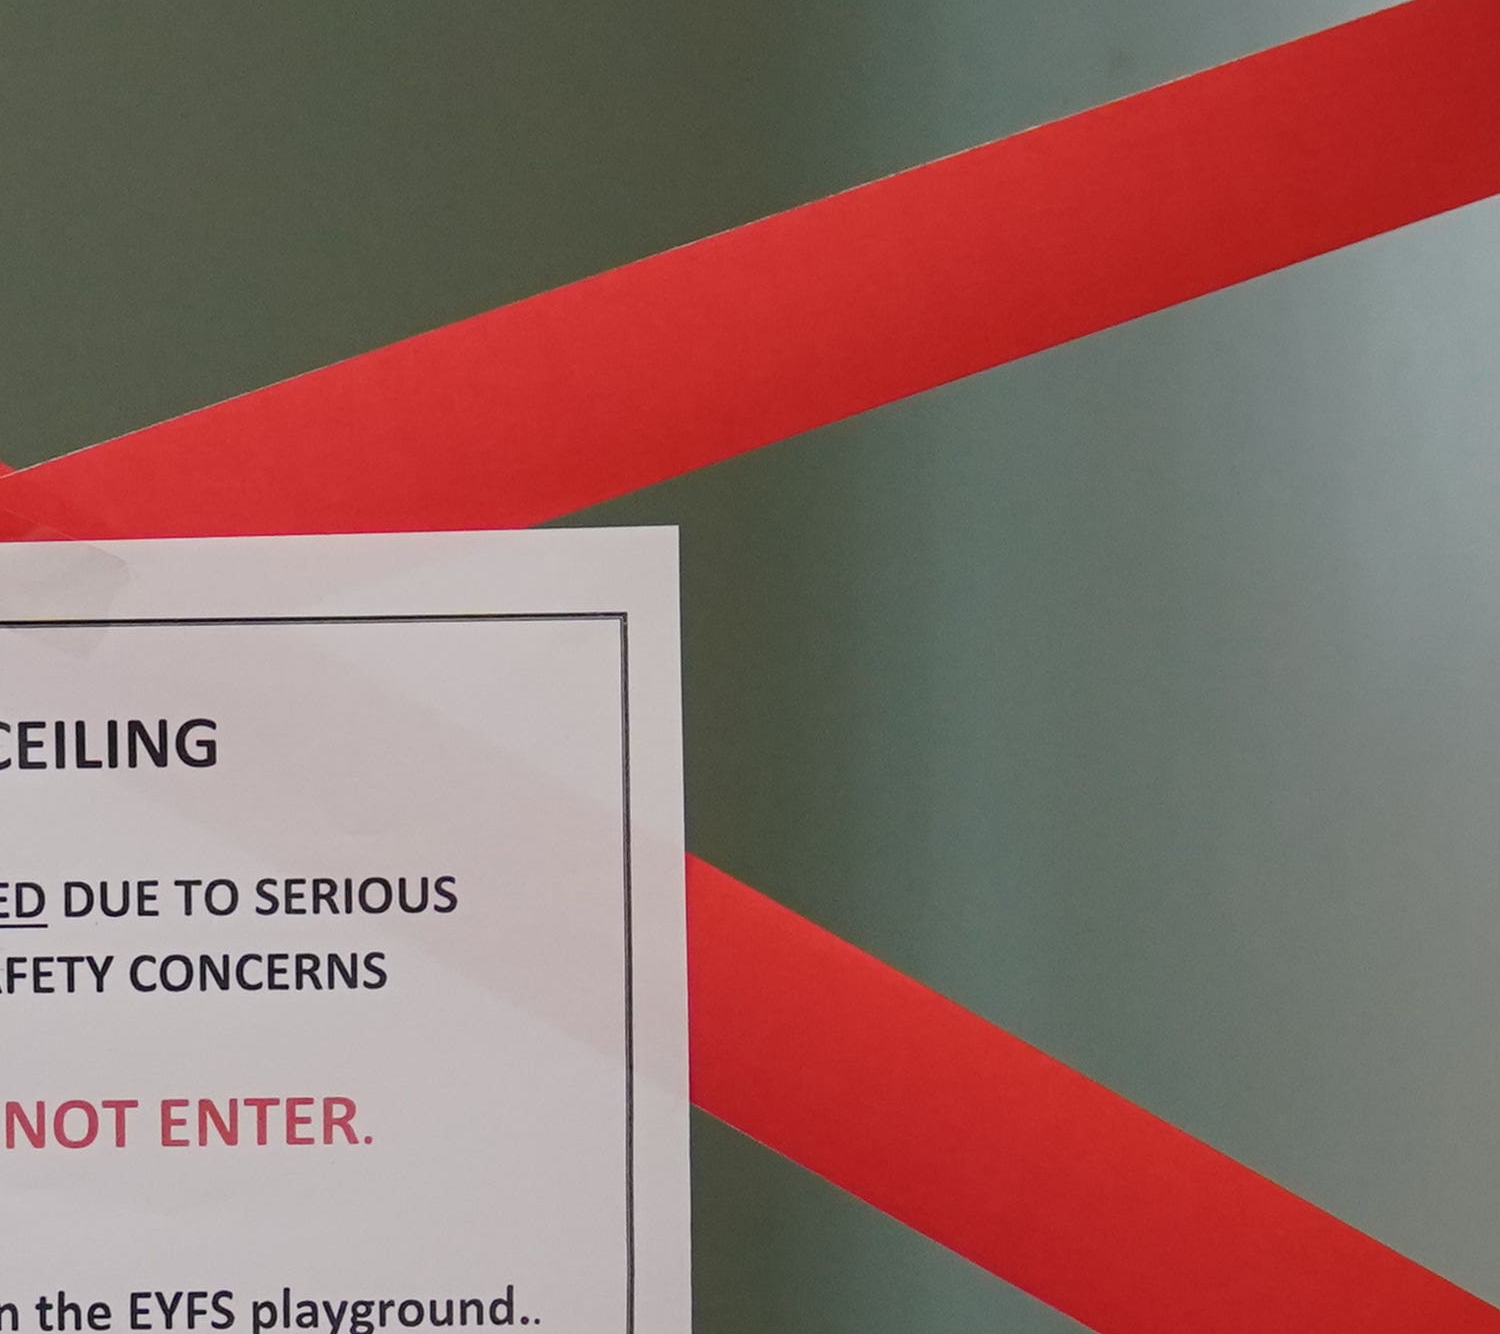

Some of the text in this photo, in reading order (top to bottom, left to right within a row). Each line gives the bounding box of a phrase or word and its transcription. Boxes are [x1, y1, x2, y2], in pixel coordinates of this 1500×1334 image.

[62, 878, 161, 919] DUE
[172, 878, 240, 918] TO
[254, 874, 459, 917] SERIOUS
[128, 950, 389, 994] CONCERNS
[4, 1098, 140, 1150] NOT
[159, 1095, 374, 1148] ENTER.
[33, 1289, 113, 1333] the
[128, 1290, 237, 1331] EYFS
